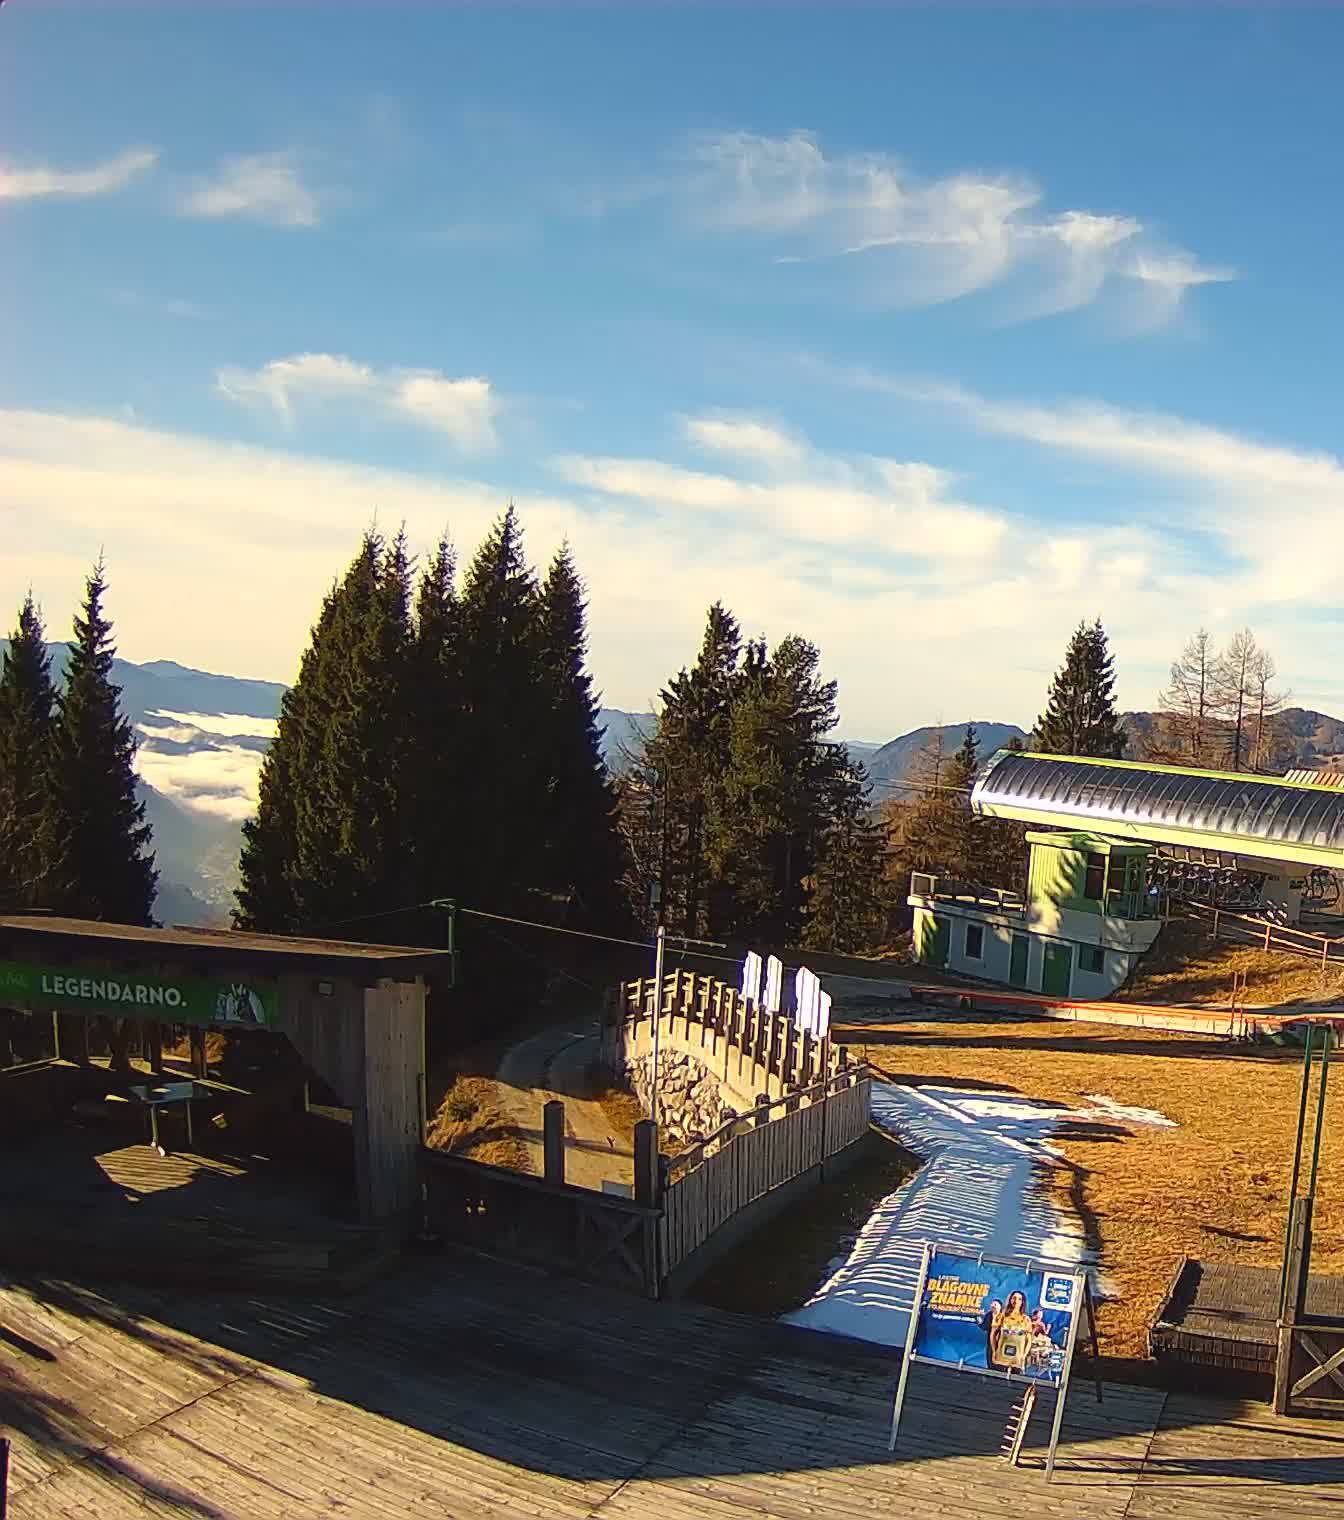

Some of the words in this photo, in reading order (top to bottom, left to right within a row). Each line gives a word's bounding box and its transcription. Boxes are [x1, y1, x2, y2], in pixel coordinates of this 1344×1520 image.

[41, 974, 188, 1007] LEGENDARNO.
[928, 1279, 990, 1296] BLAGOVNE
[930, 1292, 984, 1307] ZNAMKE
